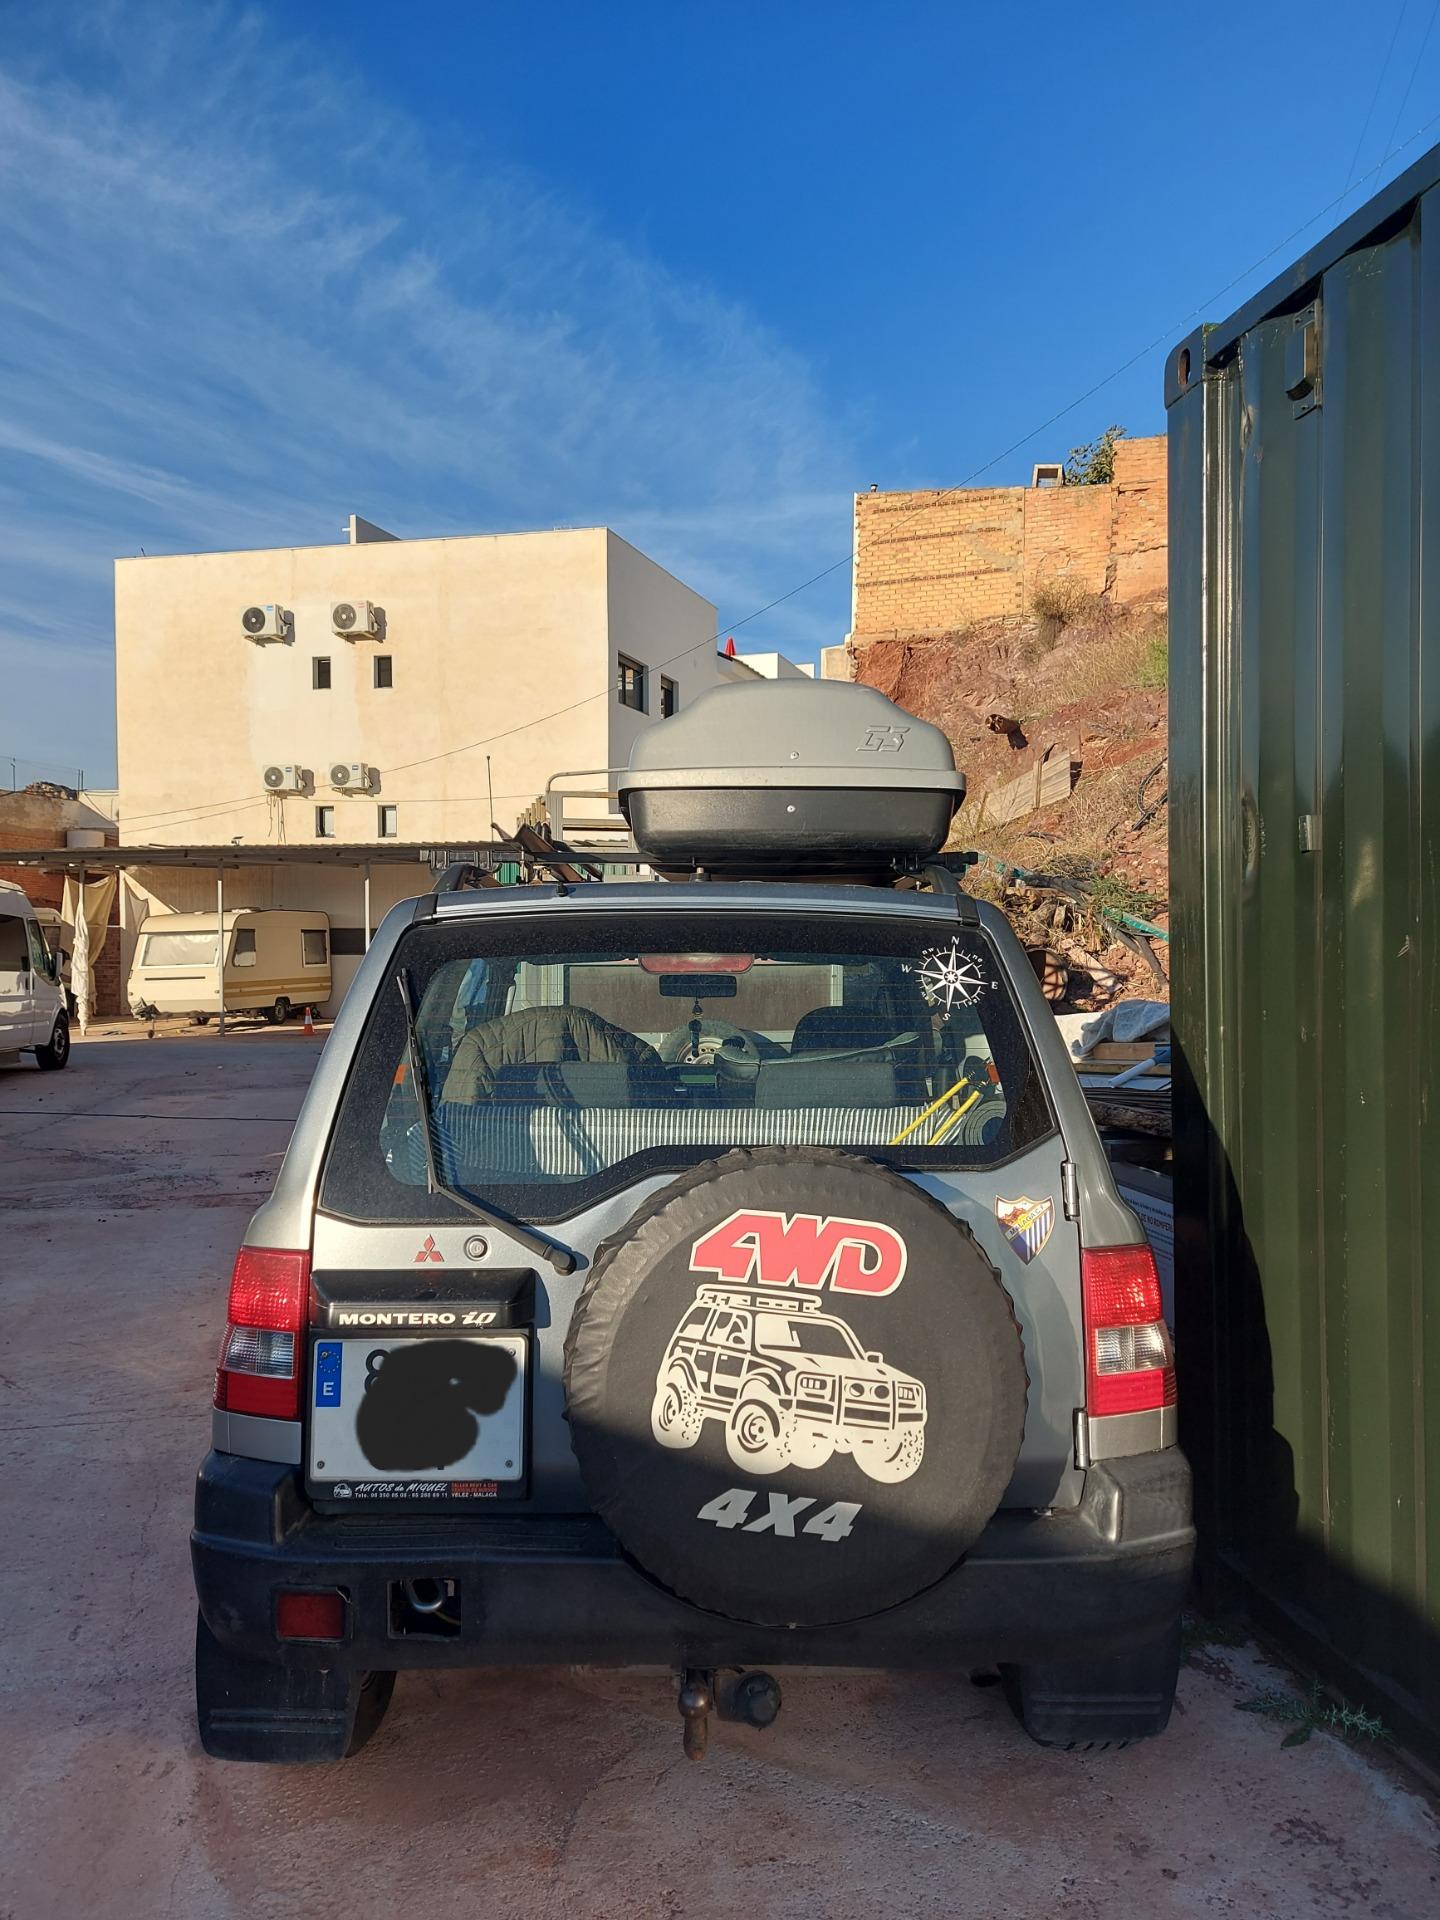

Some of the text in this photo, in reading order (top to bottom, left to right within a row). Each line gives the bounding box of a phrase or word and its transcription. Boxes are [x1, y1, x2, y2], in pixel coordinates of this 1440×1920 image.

[951, 935, 960, 945] N
[901, 963, 913, 973] W
[991, 981, 999, 990] E
[942, 1013, 951, 1021] S
[689, 1209, 908, 1297] 4WD
[339, 1312, 456, 1325] MONTERO
[323, 1382, 334, 1396] E
[355, 1483, 395, 1492] AUTOS
[406, 1483, 448, 1492] MIGUEL
[697, 1488, 863, 1542] 4X4
